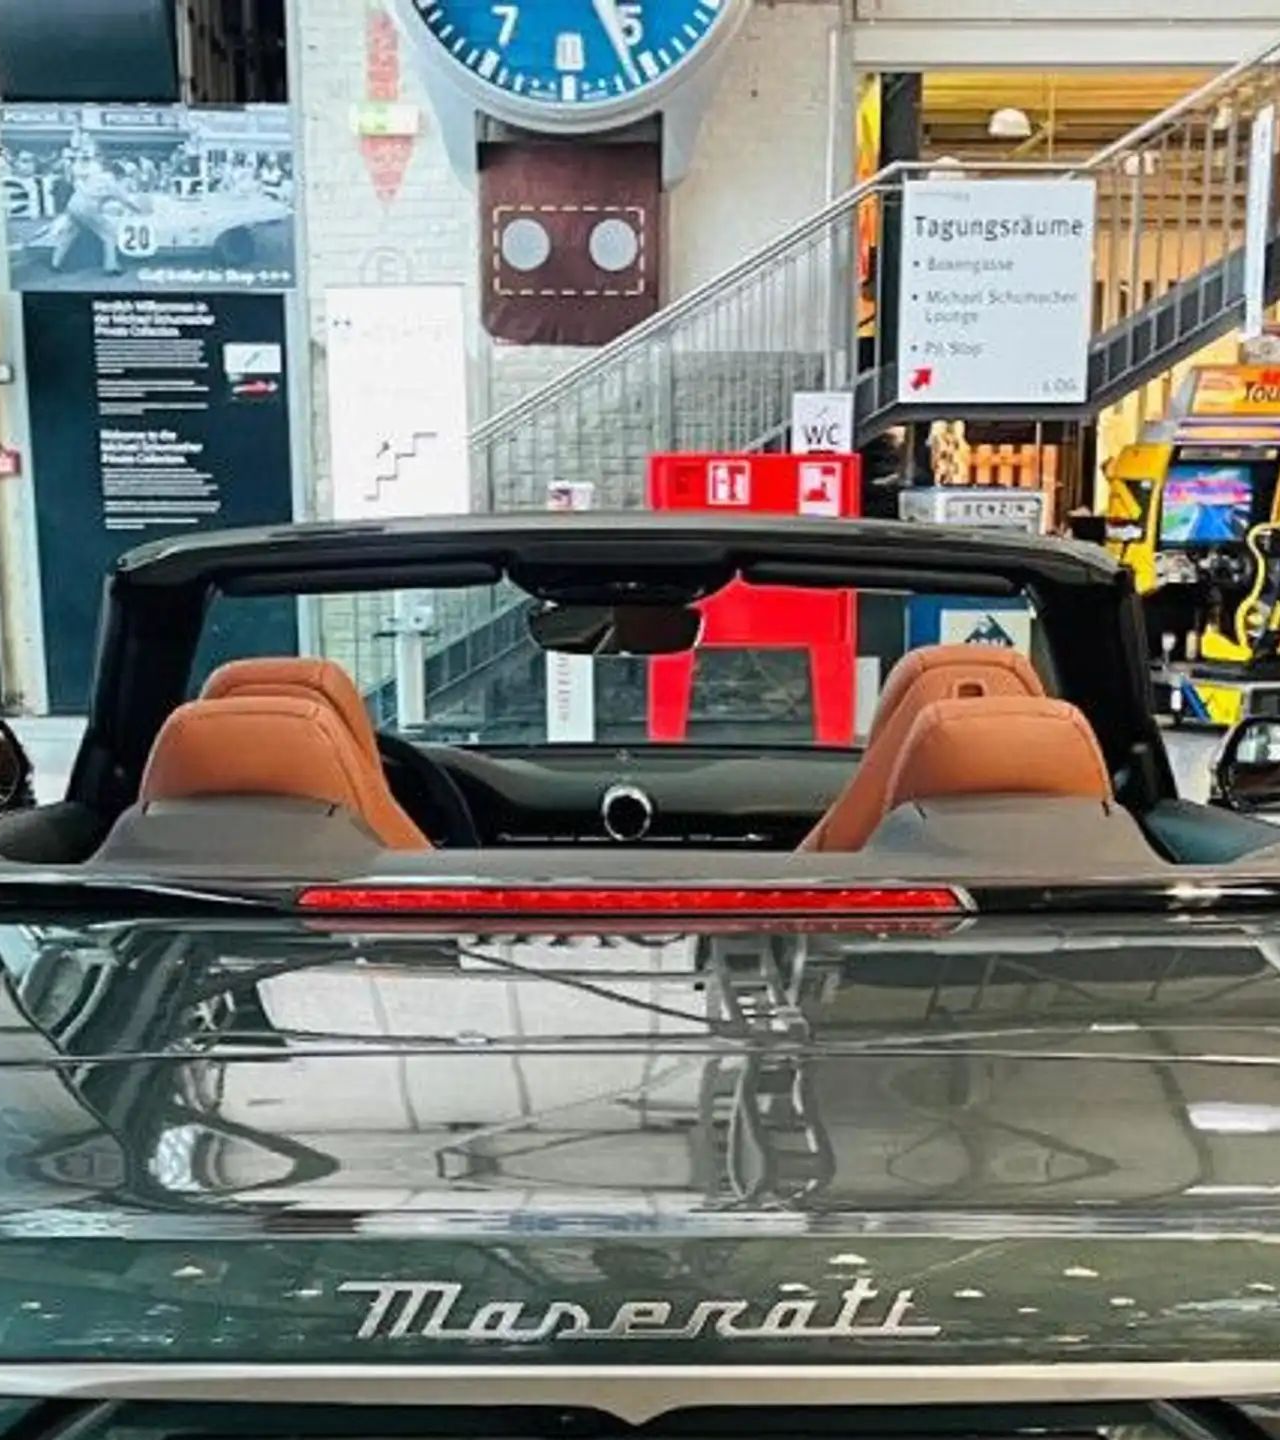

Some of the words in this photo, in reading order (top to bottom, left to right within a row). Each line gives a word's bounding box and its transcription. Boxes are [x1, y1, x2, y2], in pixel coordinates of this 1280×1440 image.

[492, 4, 518, 47] 7
[619, 4, 643, 45] 5
[123, 225, 150, 250] 20
[913, 214, 1084, 242] Tagungsräume
[801, 422, 839, 445] WC
[336, 1277, 942, 1340] Maserati
